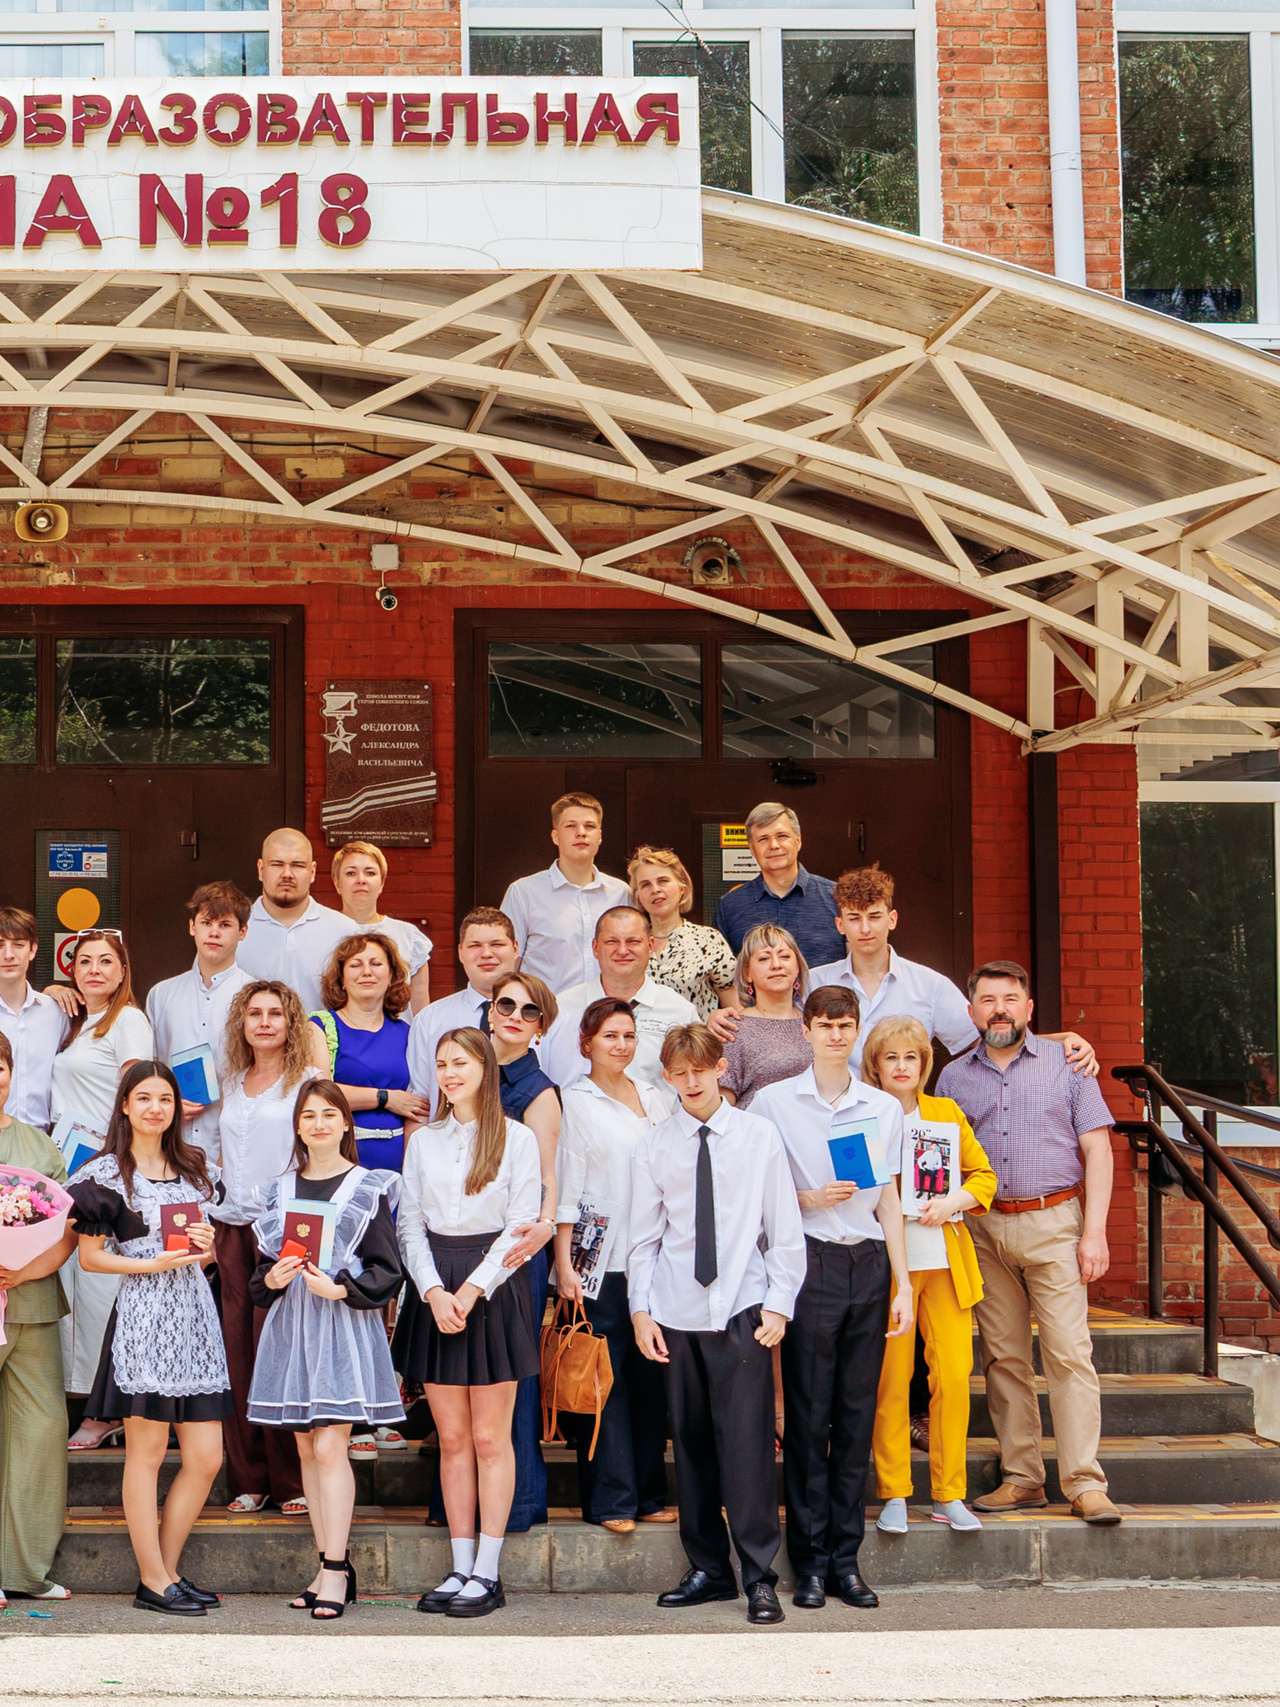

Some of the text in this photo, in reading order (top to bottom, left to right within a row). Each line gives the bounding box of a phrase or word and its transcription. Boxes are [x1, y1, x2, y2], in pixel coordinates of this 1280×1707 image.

[138, 171, 372, 250] №18
[360, 723, 420, 732] ФЕДОТОВА
[358, 759, 424, 767] ВАСИЛЬЕВИЧА
[725, 828, 746, 836] ВНИМ
